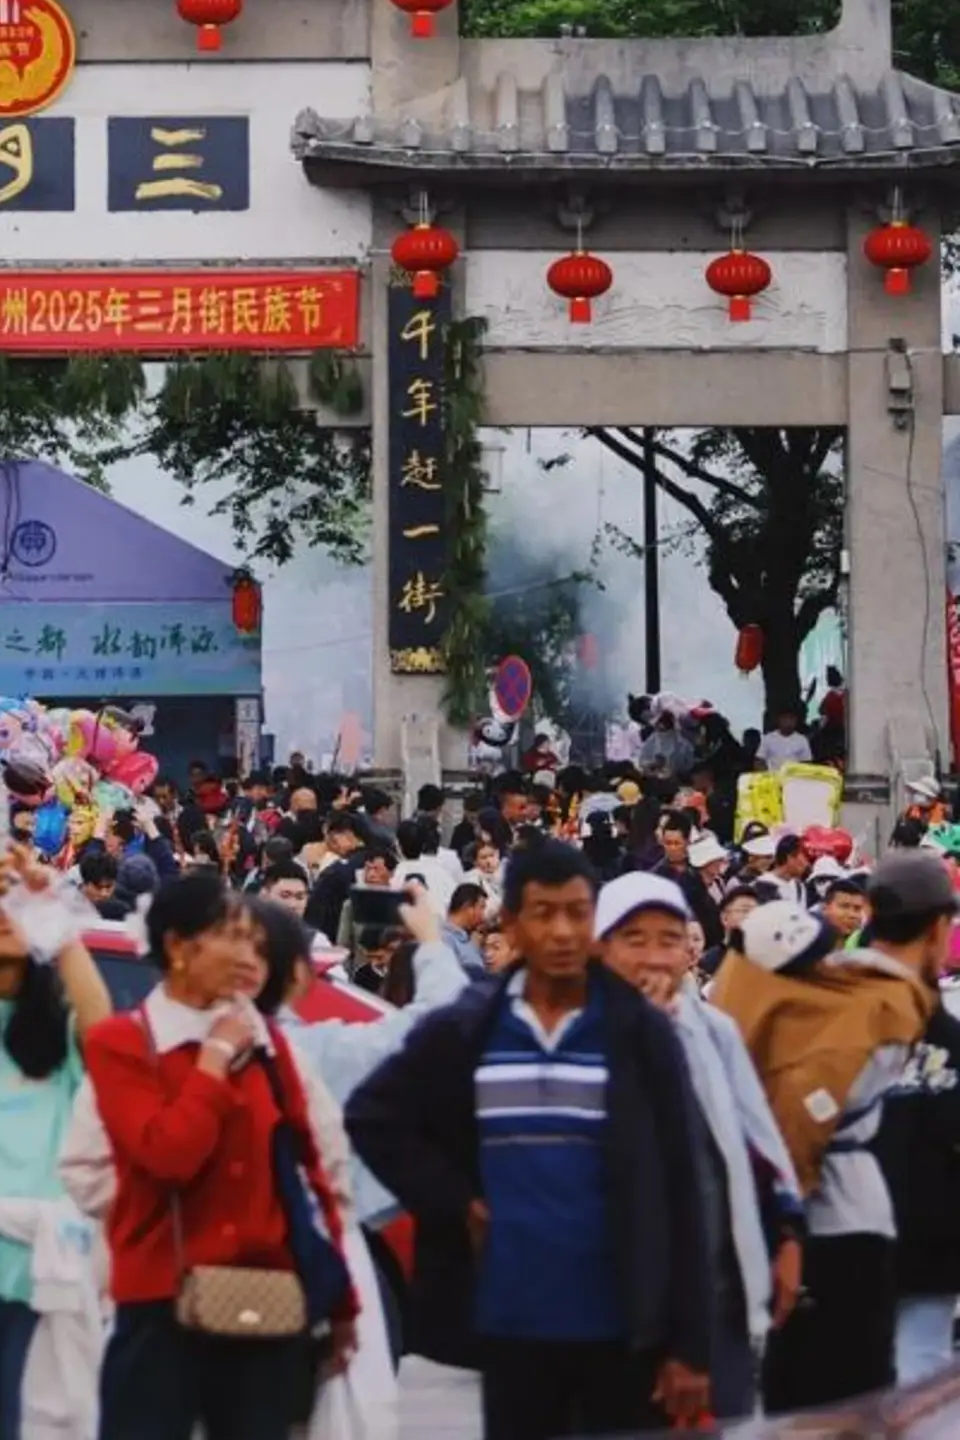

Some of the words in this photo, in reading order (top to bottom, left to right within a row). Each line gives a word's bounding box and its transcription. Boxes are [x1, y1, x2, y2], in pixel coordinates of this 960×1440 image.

[398, 308, 445, 625] 千年赶一街
